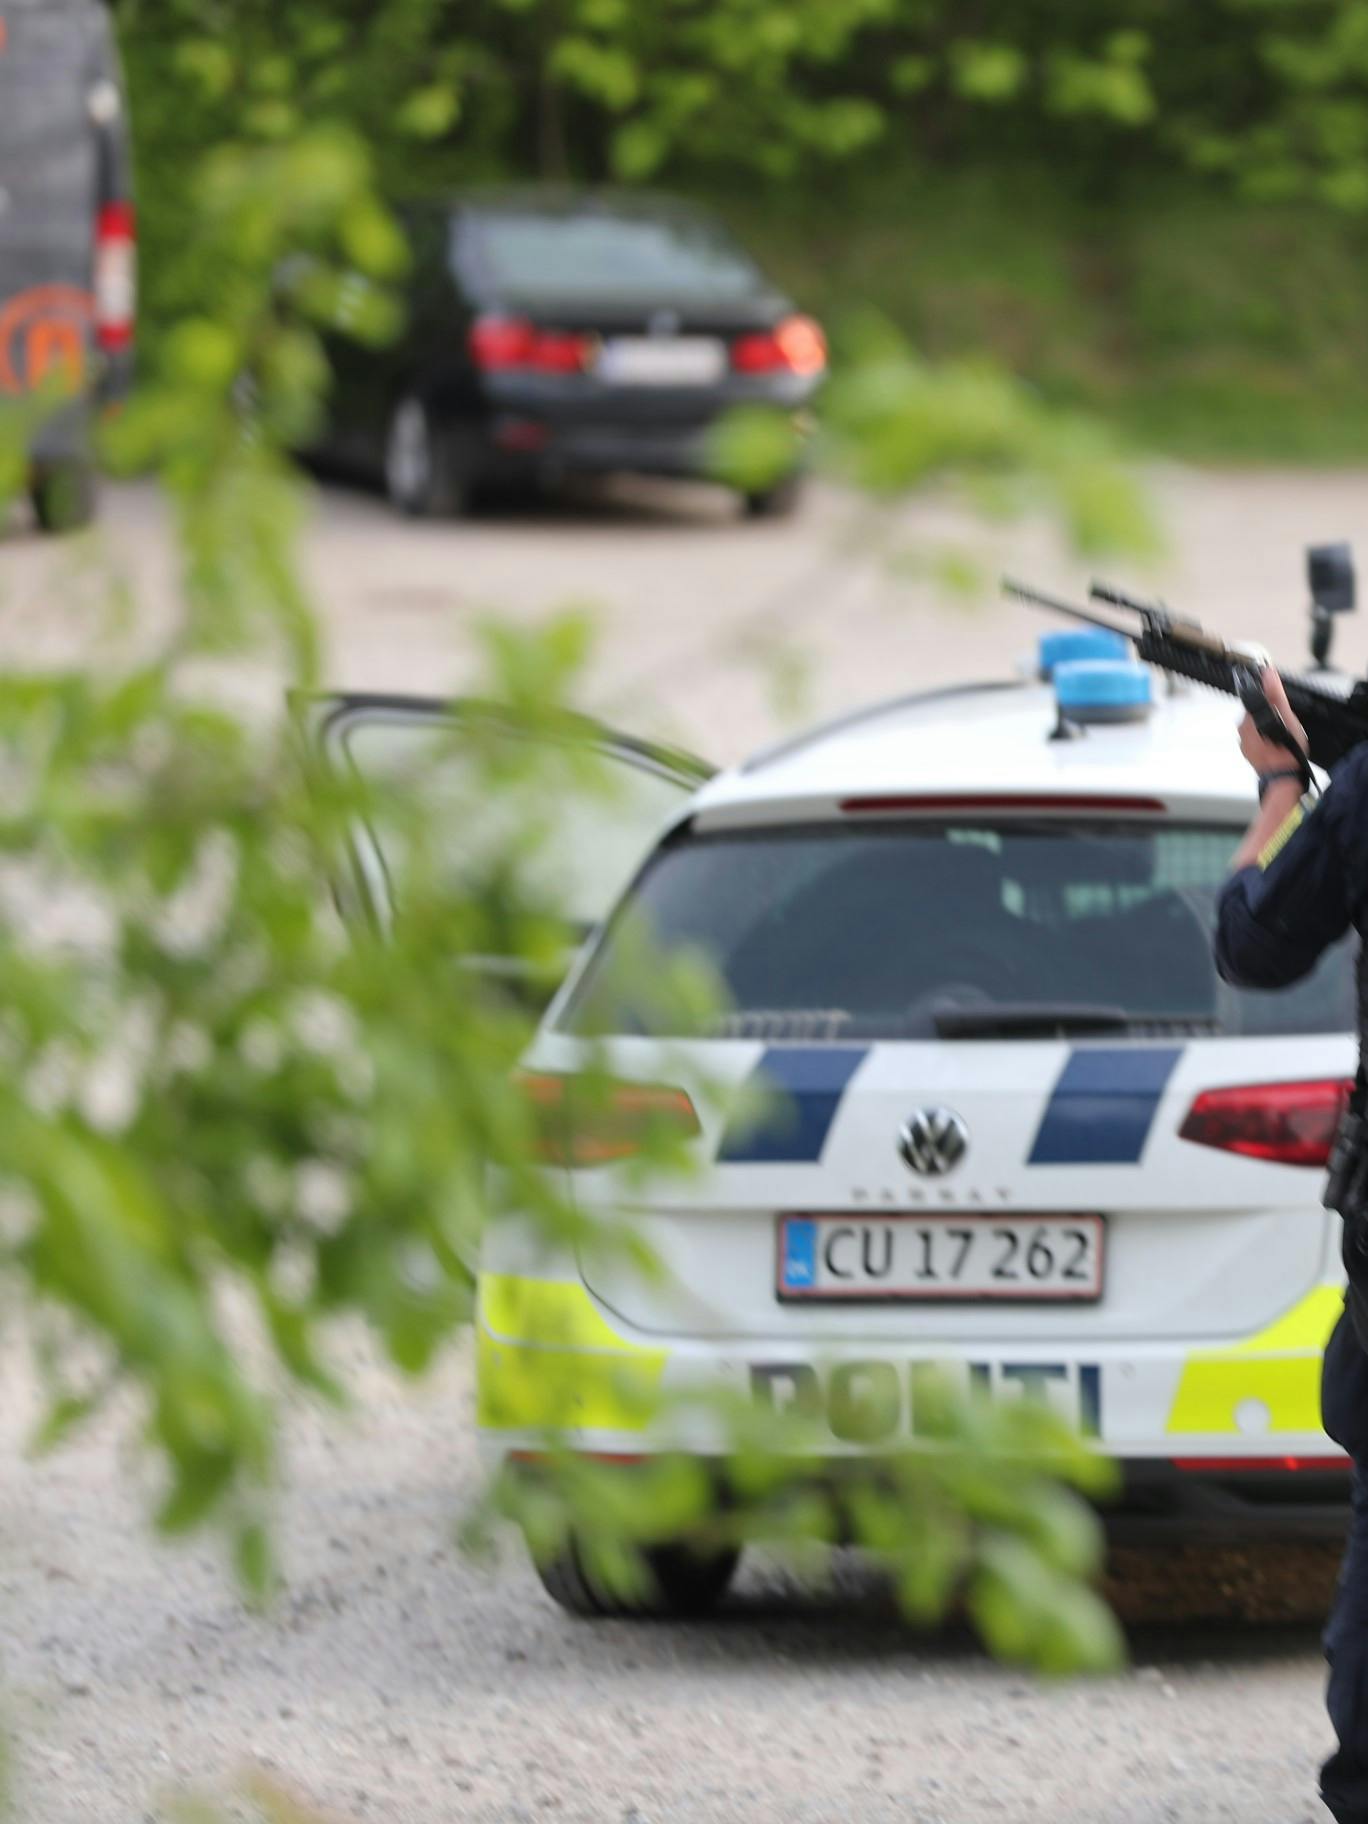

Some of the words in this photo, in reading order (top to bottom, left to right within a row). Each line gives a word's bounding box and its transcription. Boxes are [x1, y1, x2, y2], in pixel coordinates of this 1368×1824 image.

[823, 1227, 895, 1280] CU
[914, 1227, 975, 1280] 17
[990, 1227, 1090, 1281] 262
